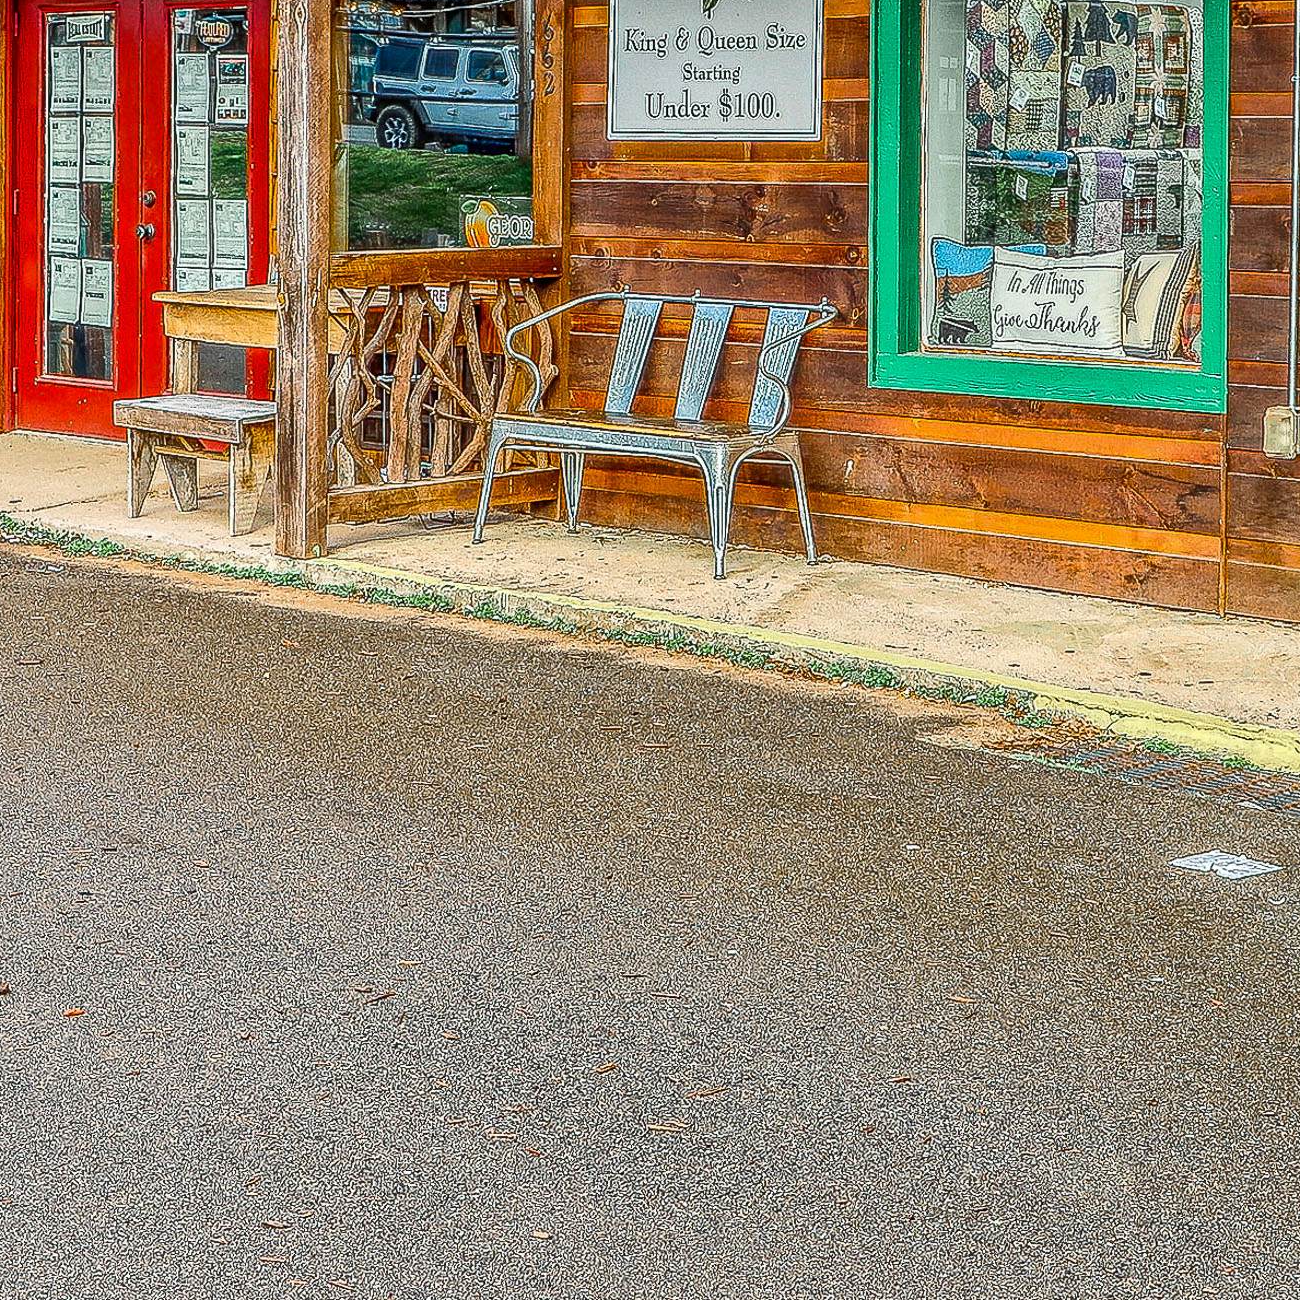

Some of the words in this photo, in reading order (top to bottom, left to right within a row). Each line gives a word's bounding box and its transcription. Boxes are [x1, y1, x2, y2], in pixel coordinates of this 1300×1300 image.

[623, 28, 668, 58] King
[675, 27, 691, 51] &
[698, 25, 758, 56] Queen
[765, 22, 806, 49] Size
[682, 62, 741, 85] Starting
[645, 89, 711, 119] Under
[718, 88, 781, 122] $100.
[1006, 270, 1023, 293] In
[1022, 272, 1047, 294] All
[1045, 271, 1085, 304] Things
[994, 303, 1024, 338] Give
[1024, 301, 1101, 338] Thanks
